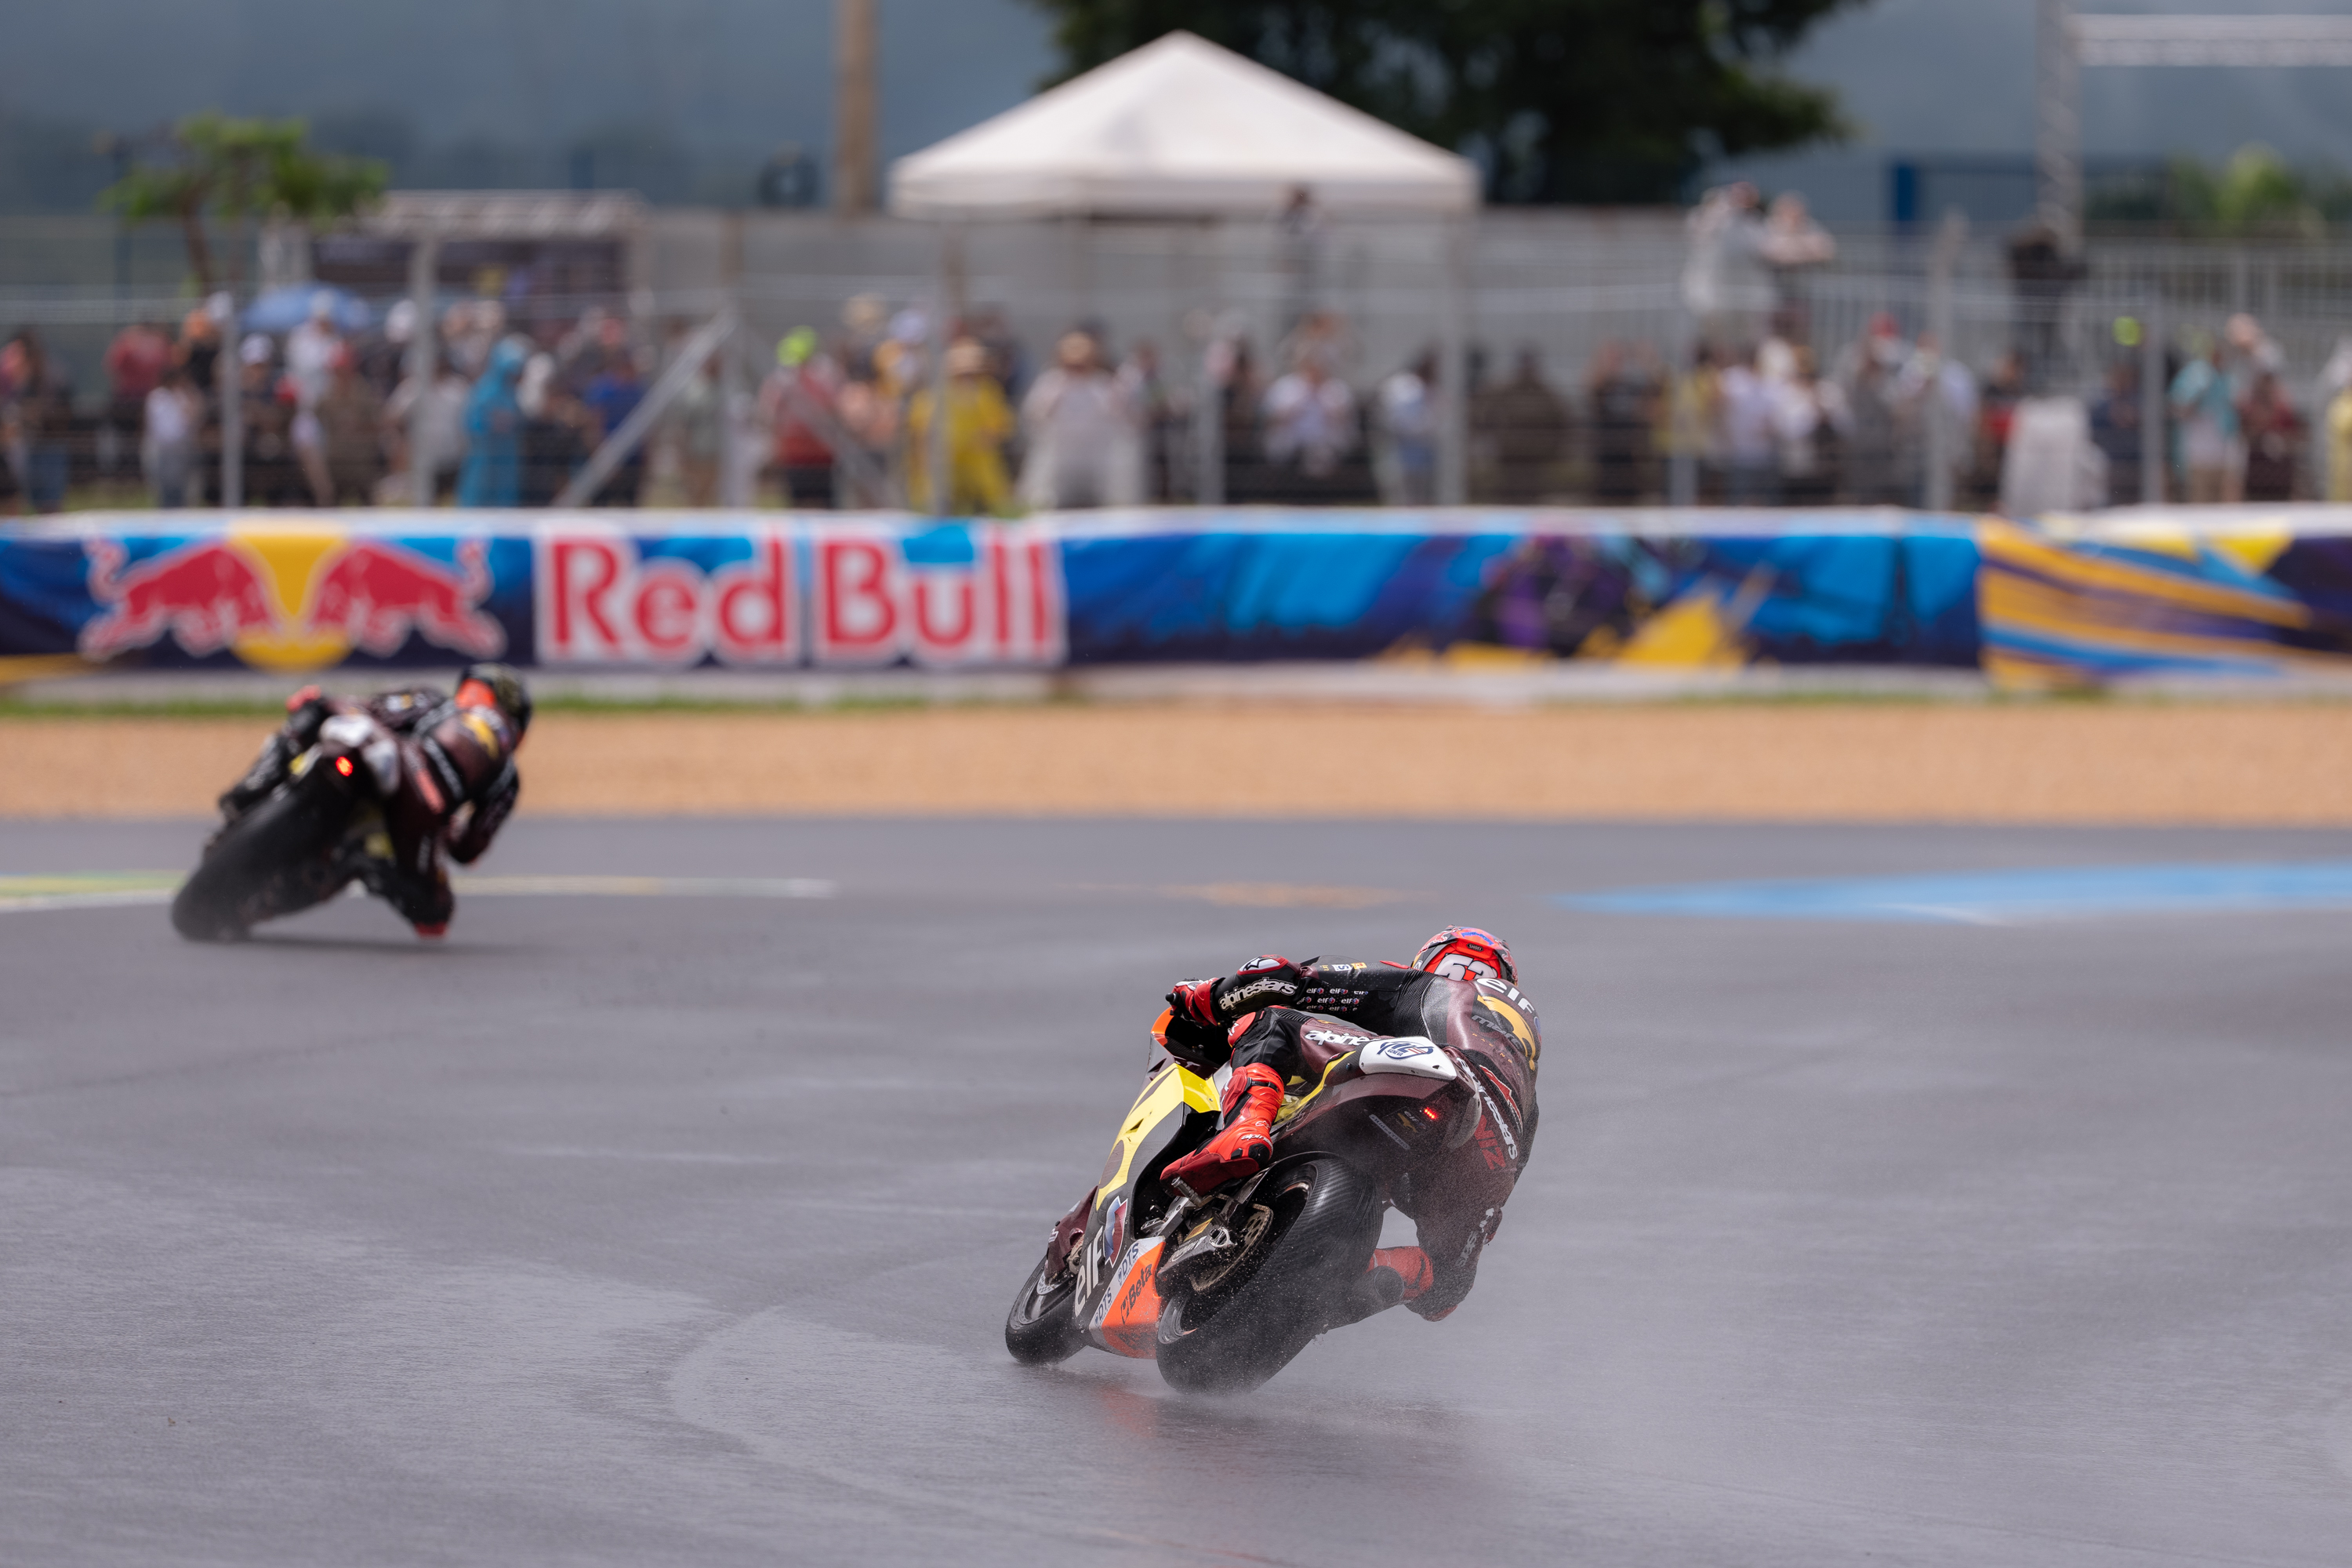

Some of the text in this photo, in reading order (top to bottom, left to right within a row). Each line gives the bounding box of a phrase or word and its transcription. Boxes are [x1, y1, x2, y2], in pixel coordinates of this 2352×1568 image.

[549, 530, 1049, 649] Red Bull
[1218, 976, 1298, 1011] alpinestars
[1477, 978, 1535, 1014] elf
[1305, 1029, 1382, 1046] alpine
[1074, 1225, 1104, 1318] elf
[1121, 1243, 1139, 1275] DTS
[1098, 1287, 1112, 1321] DTS
[1127, 1263, 1152, 1312] Beta
